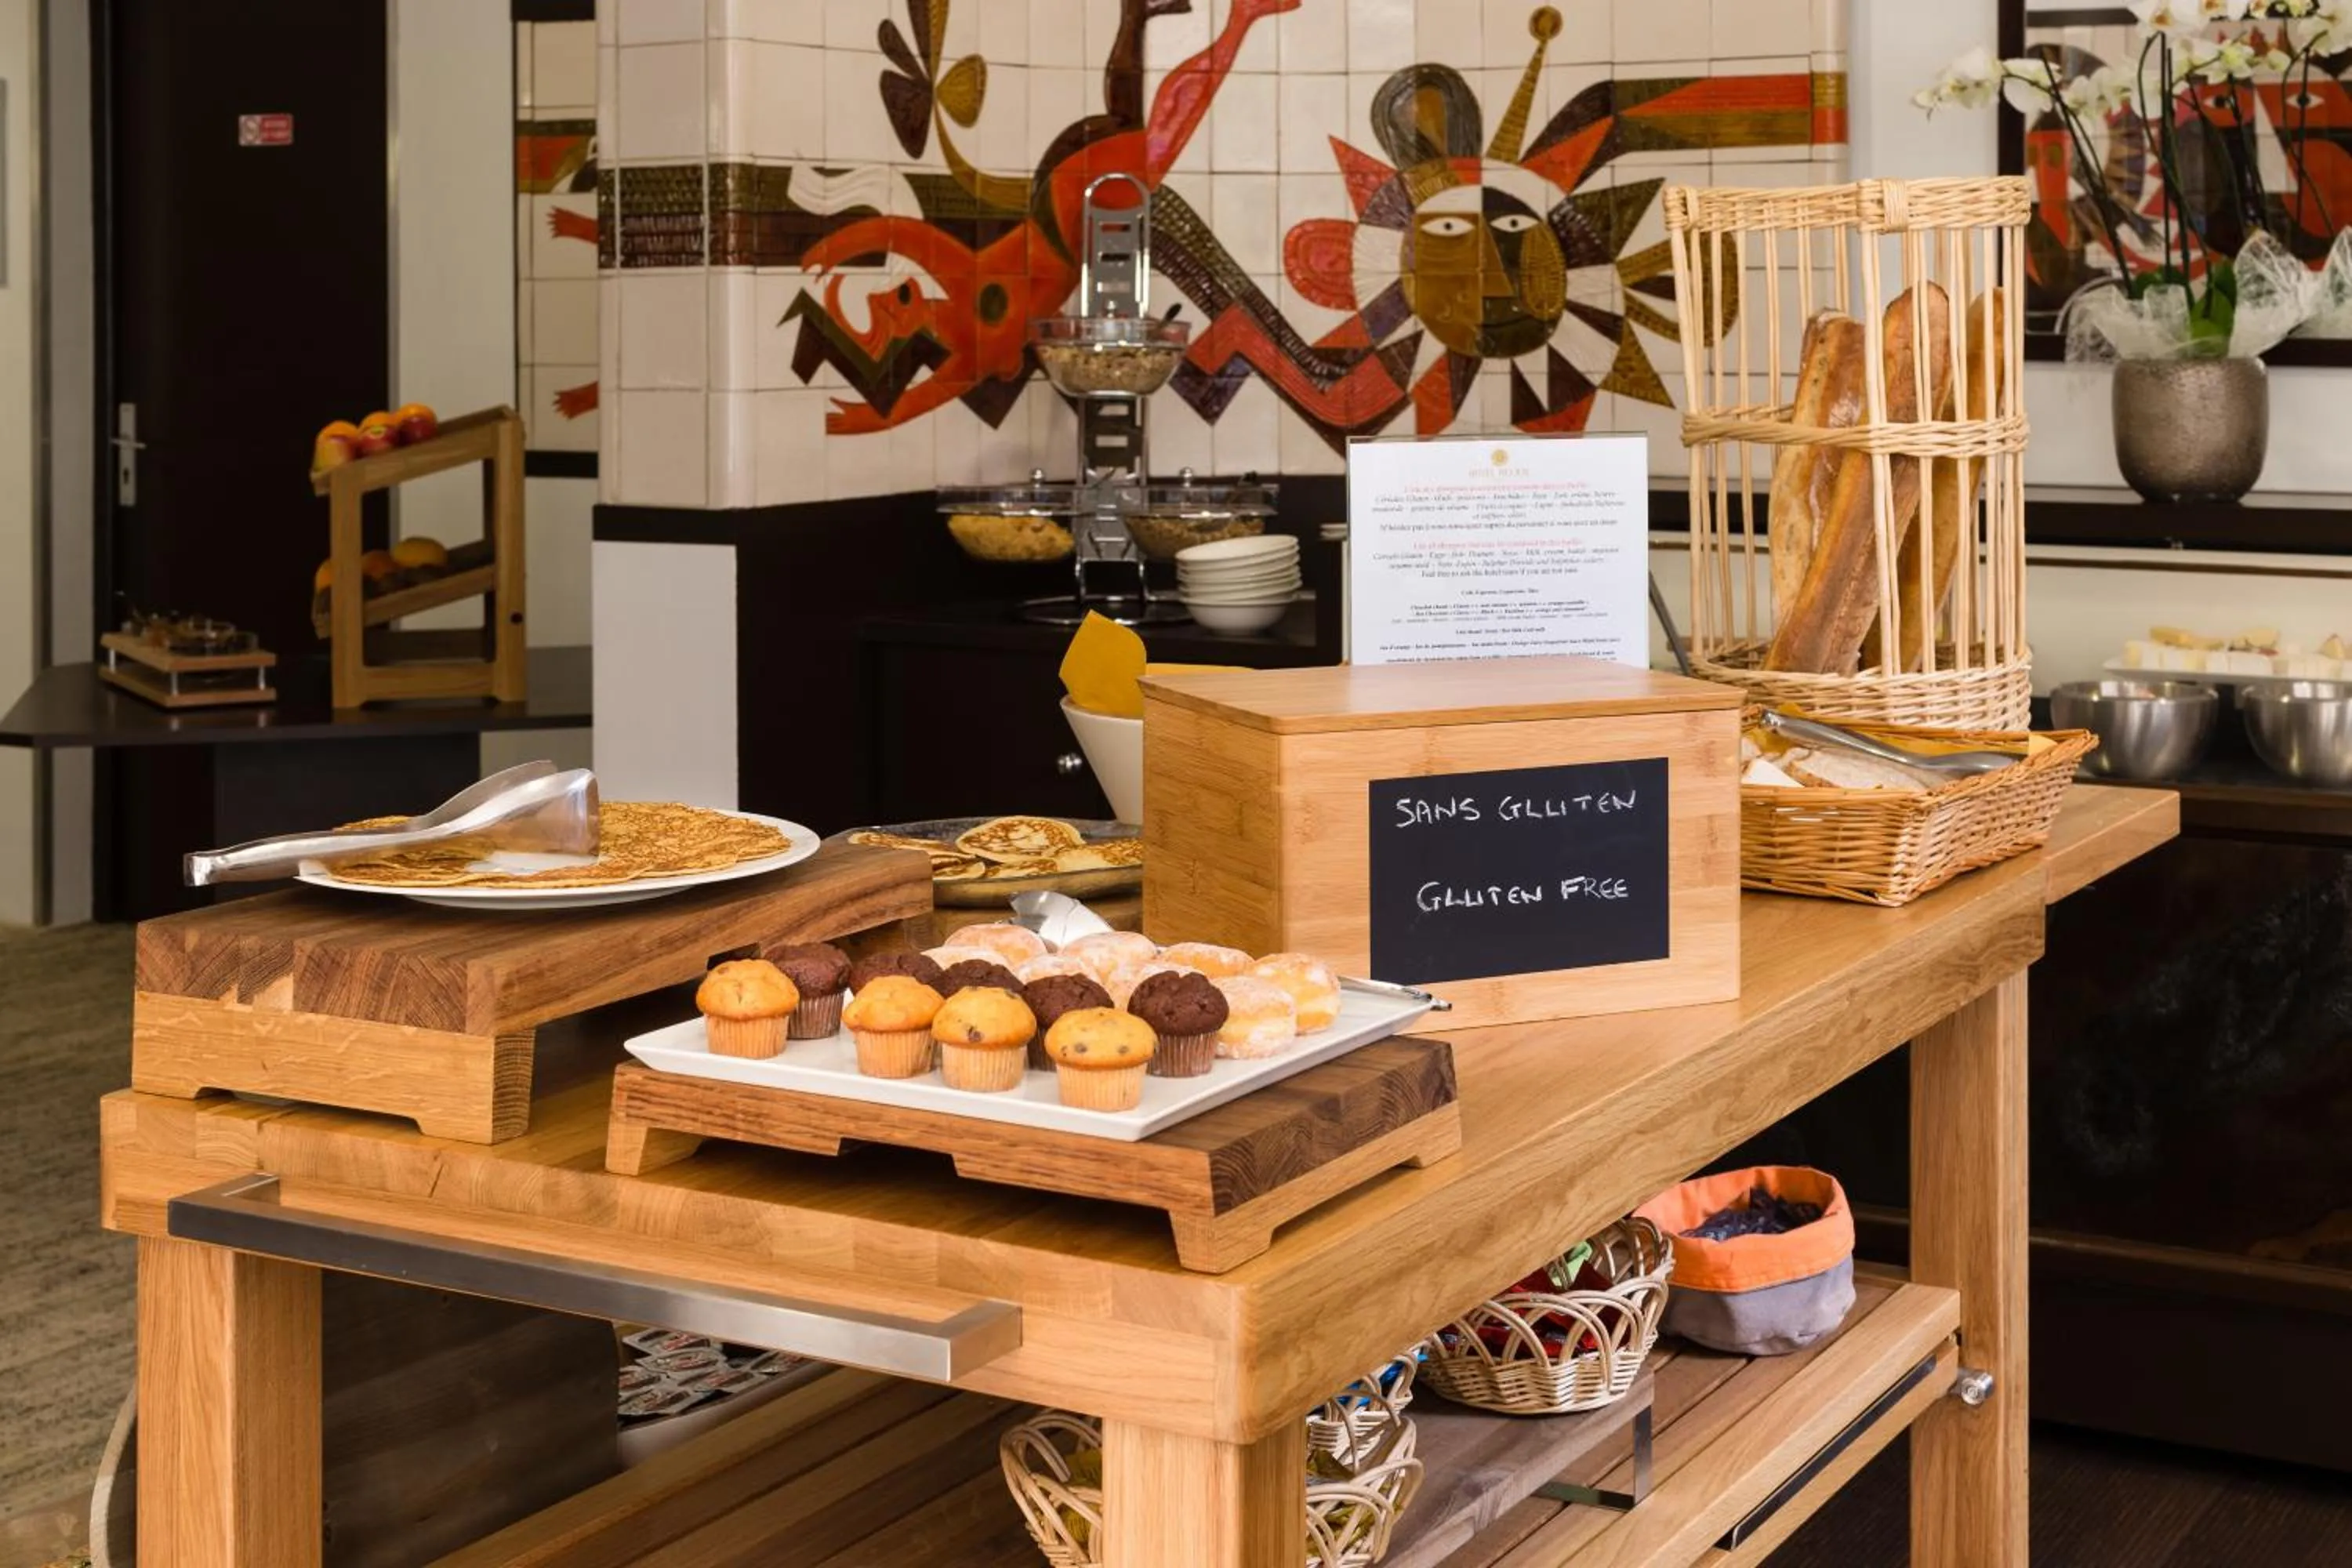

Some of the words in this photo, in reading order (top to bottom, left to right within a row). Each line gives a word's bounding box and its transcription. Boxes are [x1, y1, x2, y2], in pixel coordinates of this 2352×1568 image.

[1396, 796, 1481, 829] SANS
[1498, 789, 1637, 822] GLUTEN
[1416, 880, 1543, 913] GLUTEN
[1561, 876, 1630, 900] FREE
